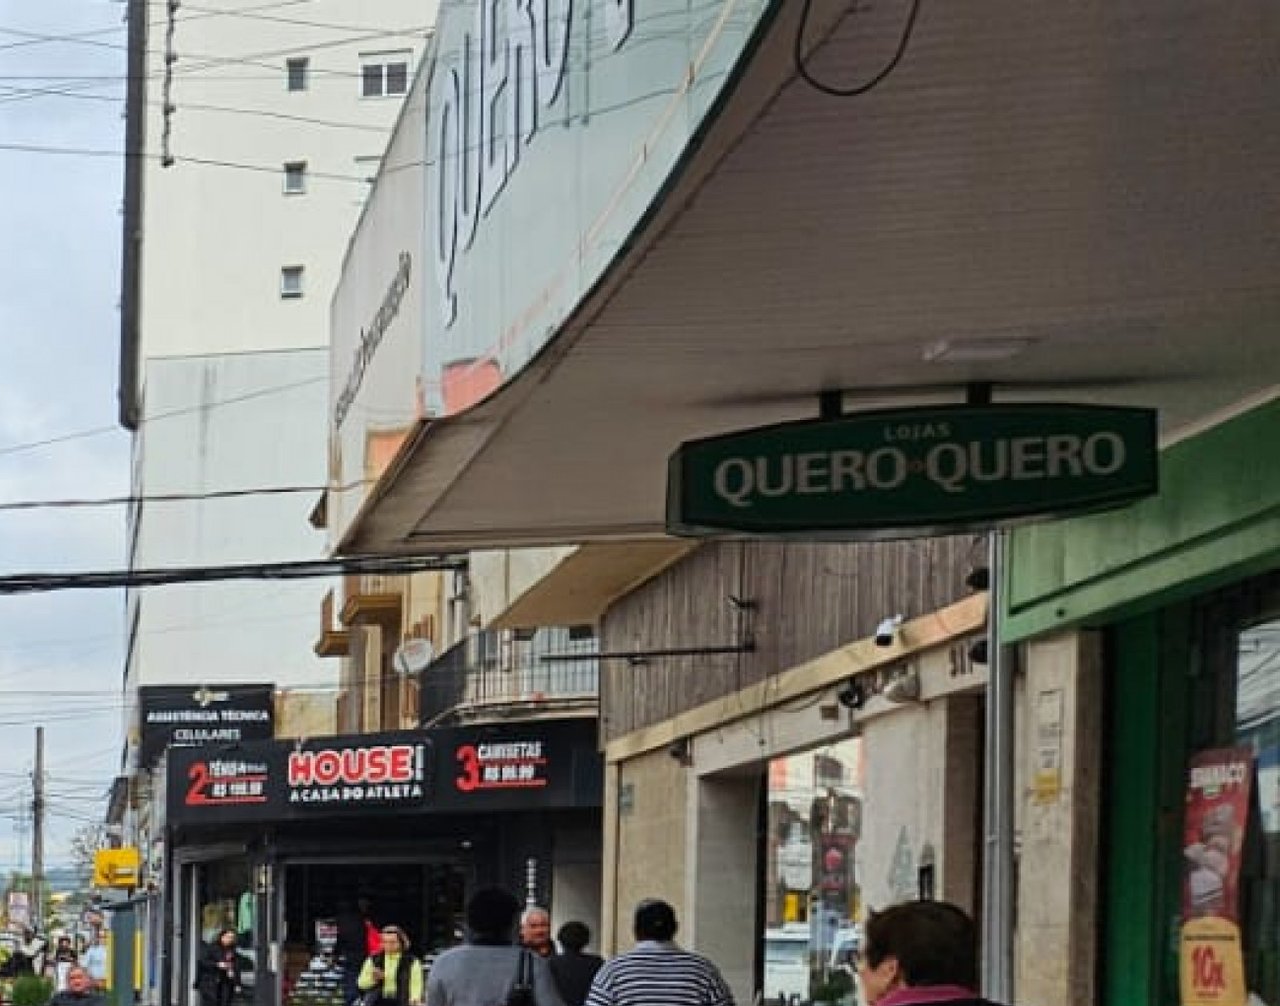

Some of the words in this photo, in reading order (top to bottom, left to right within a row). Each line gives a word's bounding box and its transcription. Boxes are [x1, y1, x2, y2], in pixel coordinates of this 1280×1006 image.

[884, 422, 951, 442] LOJAS
[713, 447, 907, 507] QUERO
[926, 431, 1126, 492] QUERO
[184, 760, 209, 805] 2
[455, 743, 480, 791] 3
[301, 787, 340, 802] CASA
[343, 786, 365, 800] DO
[366, 784, 423, 799] ATLETA
